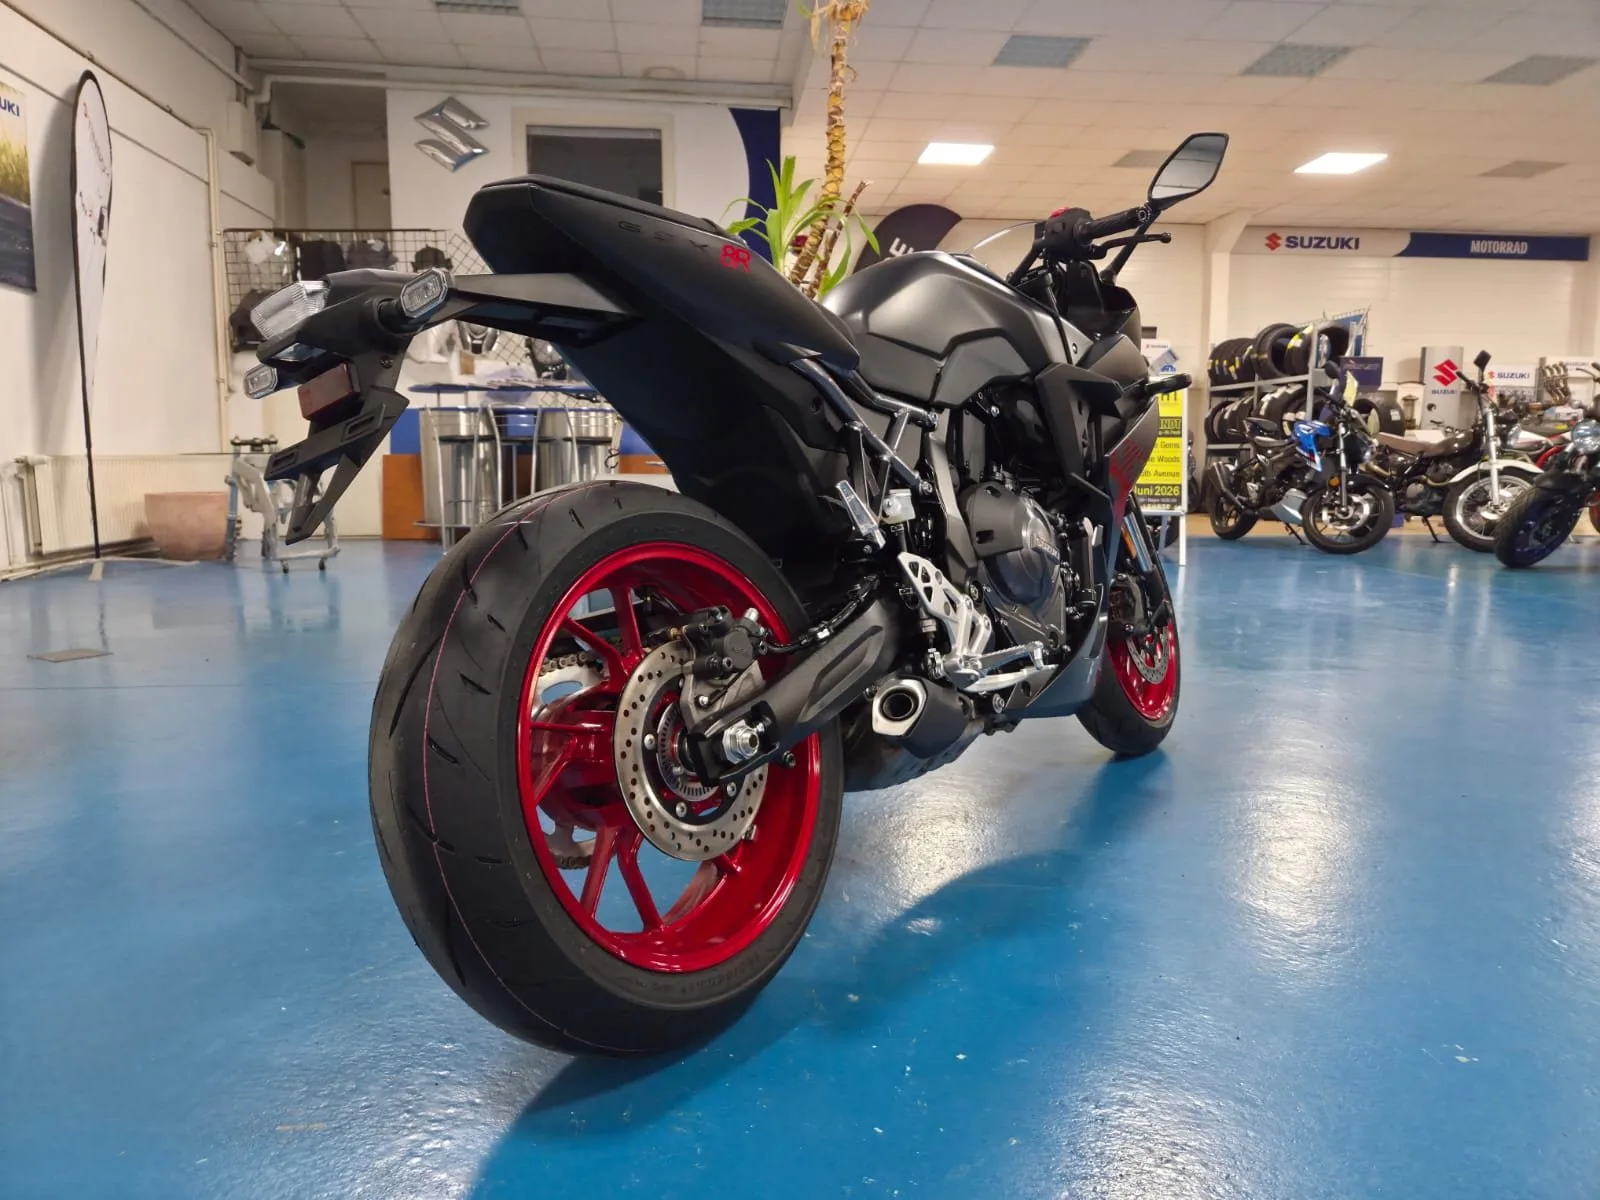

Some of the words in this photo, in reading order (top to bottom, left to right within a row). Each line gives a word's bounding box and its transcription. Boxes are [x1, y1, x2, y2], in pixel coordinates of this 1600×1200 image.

[1285, 235, 1360, 250] SUZUKI
[1470, 240, 1528, 254] MOTORRAD
[1153, 469, 1181, 478] Avenue
[1154, 485, 1180, 497] 2026
